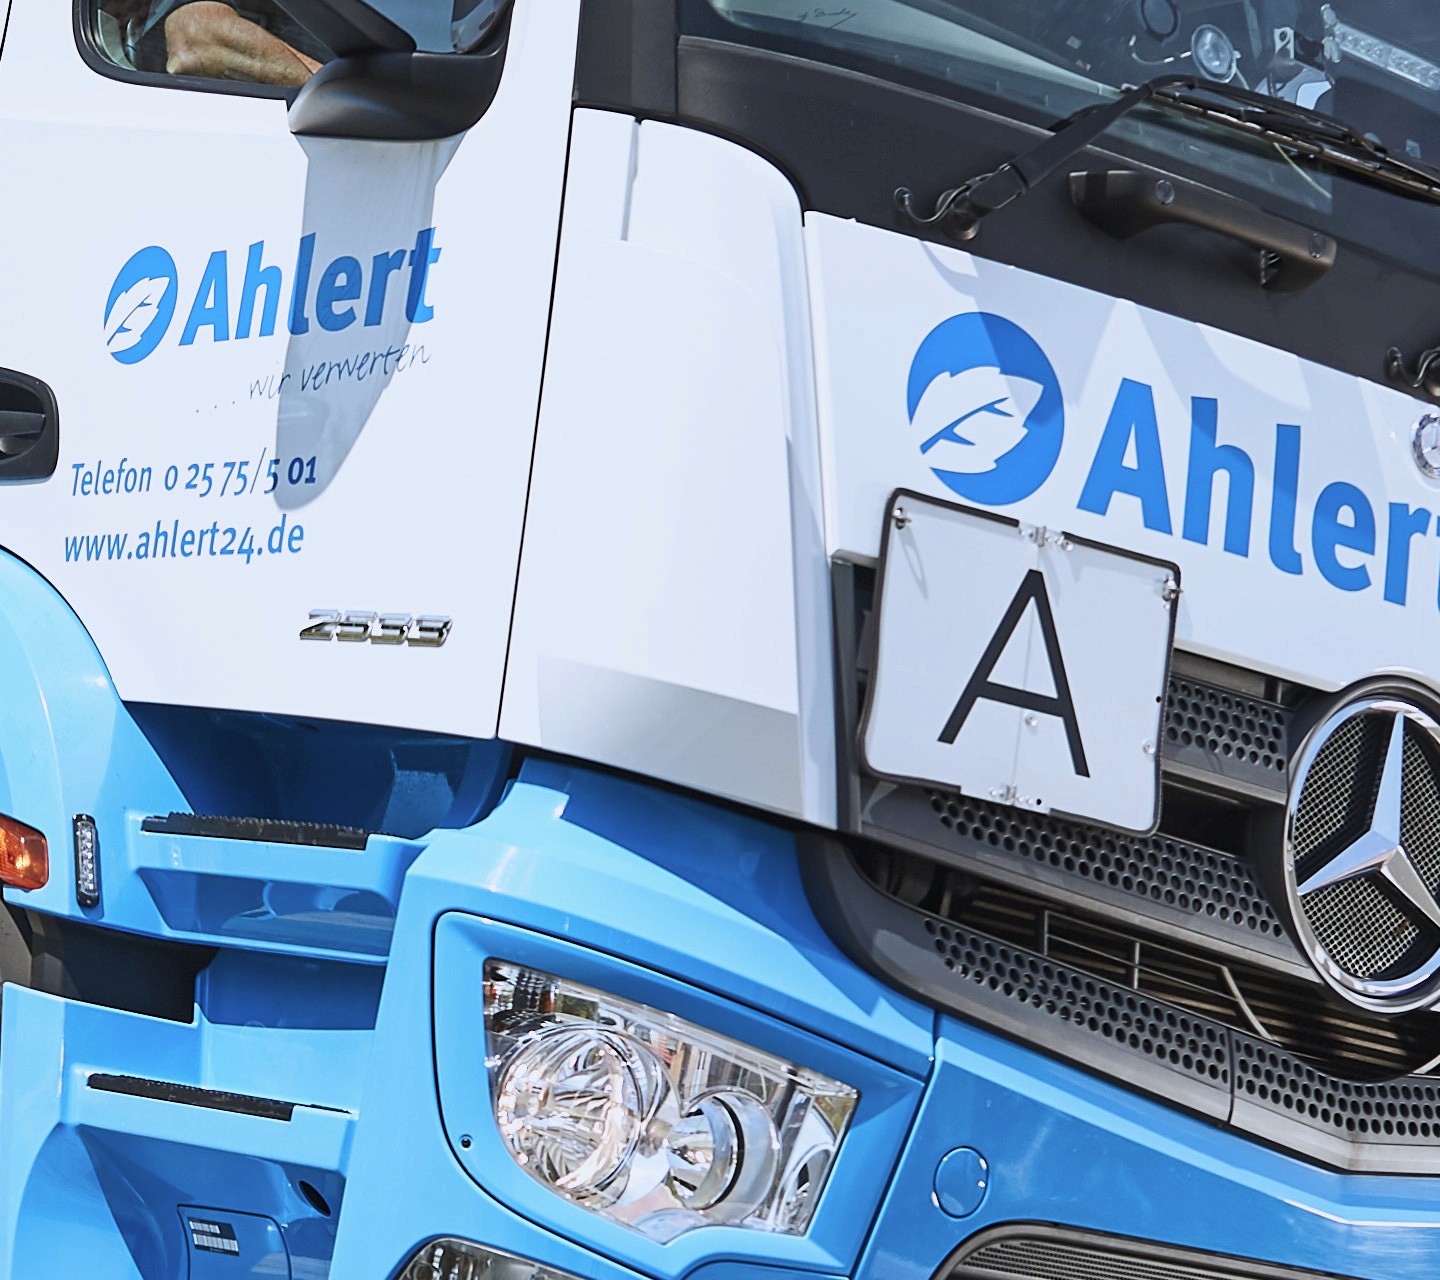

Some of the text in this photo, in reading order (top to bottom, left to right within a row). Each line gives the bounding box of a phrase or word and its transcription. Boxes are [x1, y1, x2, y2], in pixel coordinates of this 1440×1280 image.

[178, 226, 442, 347] Ahlert
[249, 363, 291, 400] wir
[301, 343, 433, 392] verwerten
[71, 457, 153, 497] Telefon
[64, 513, 305, 565] www.ahlert24.de
[299, 608, 453, 648] 2533
[936, 568, 1091, 779] A
